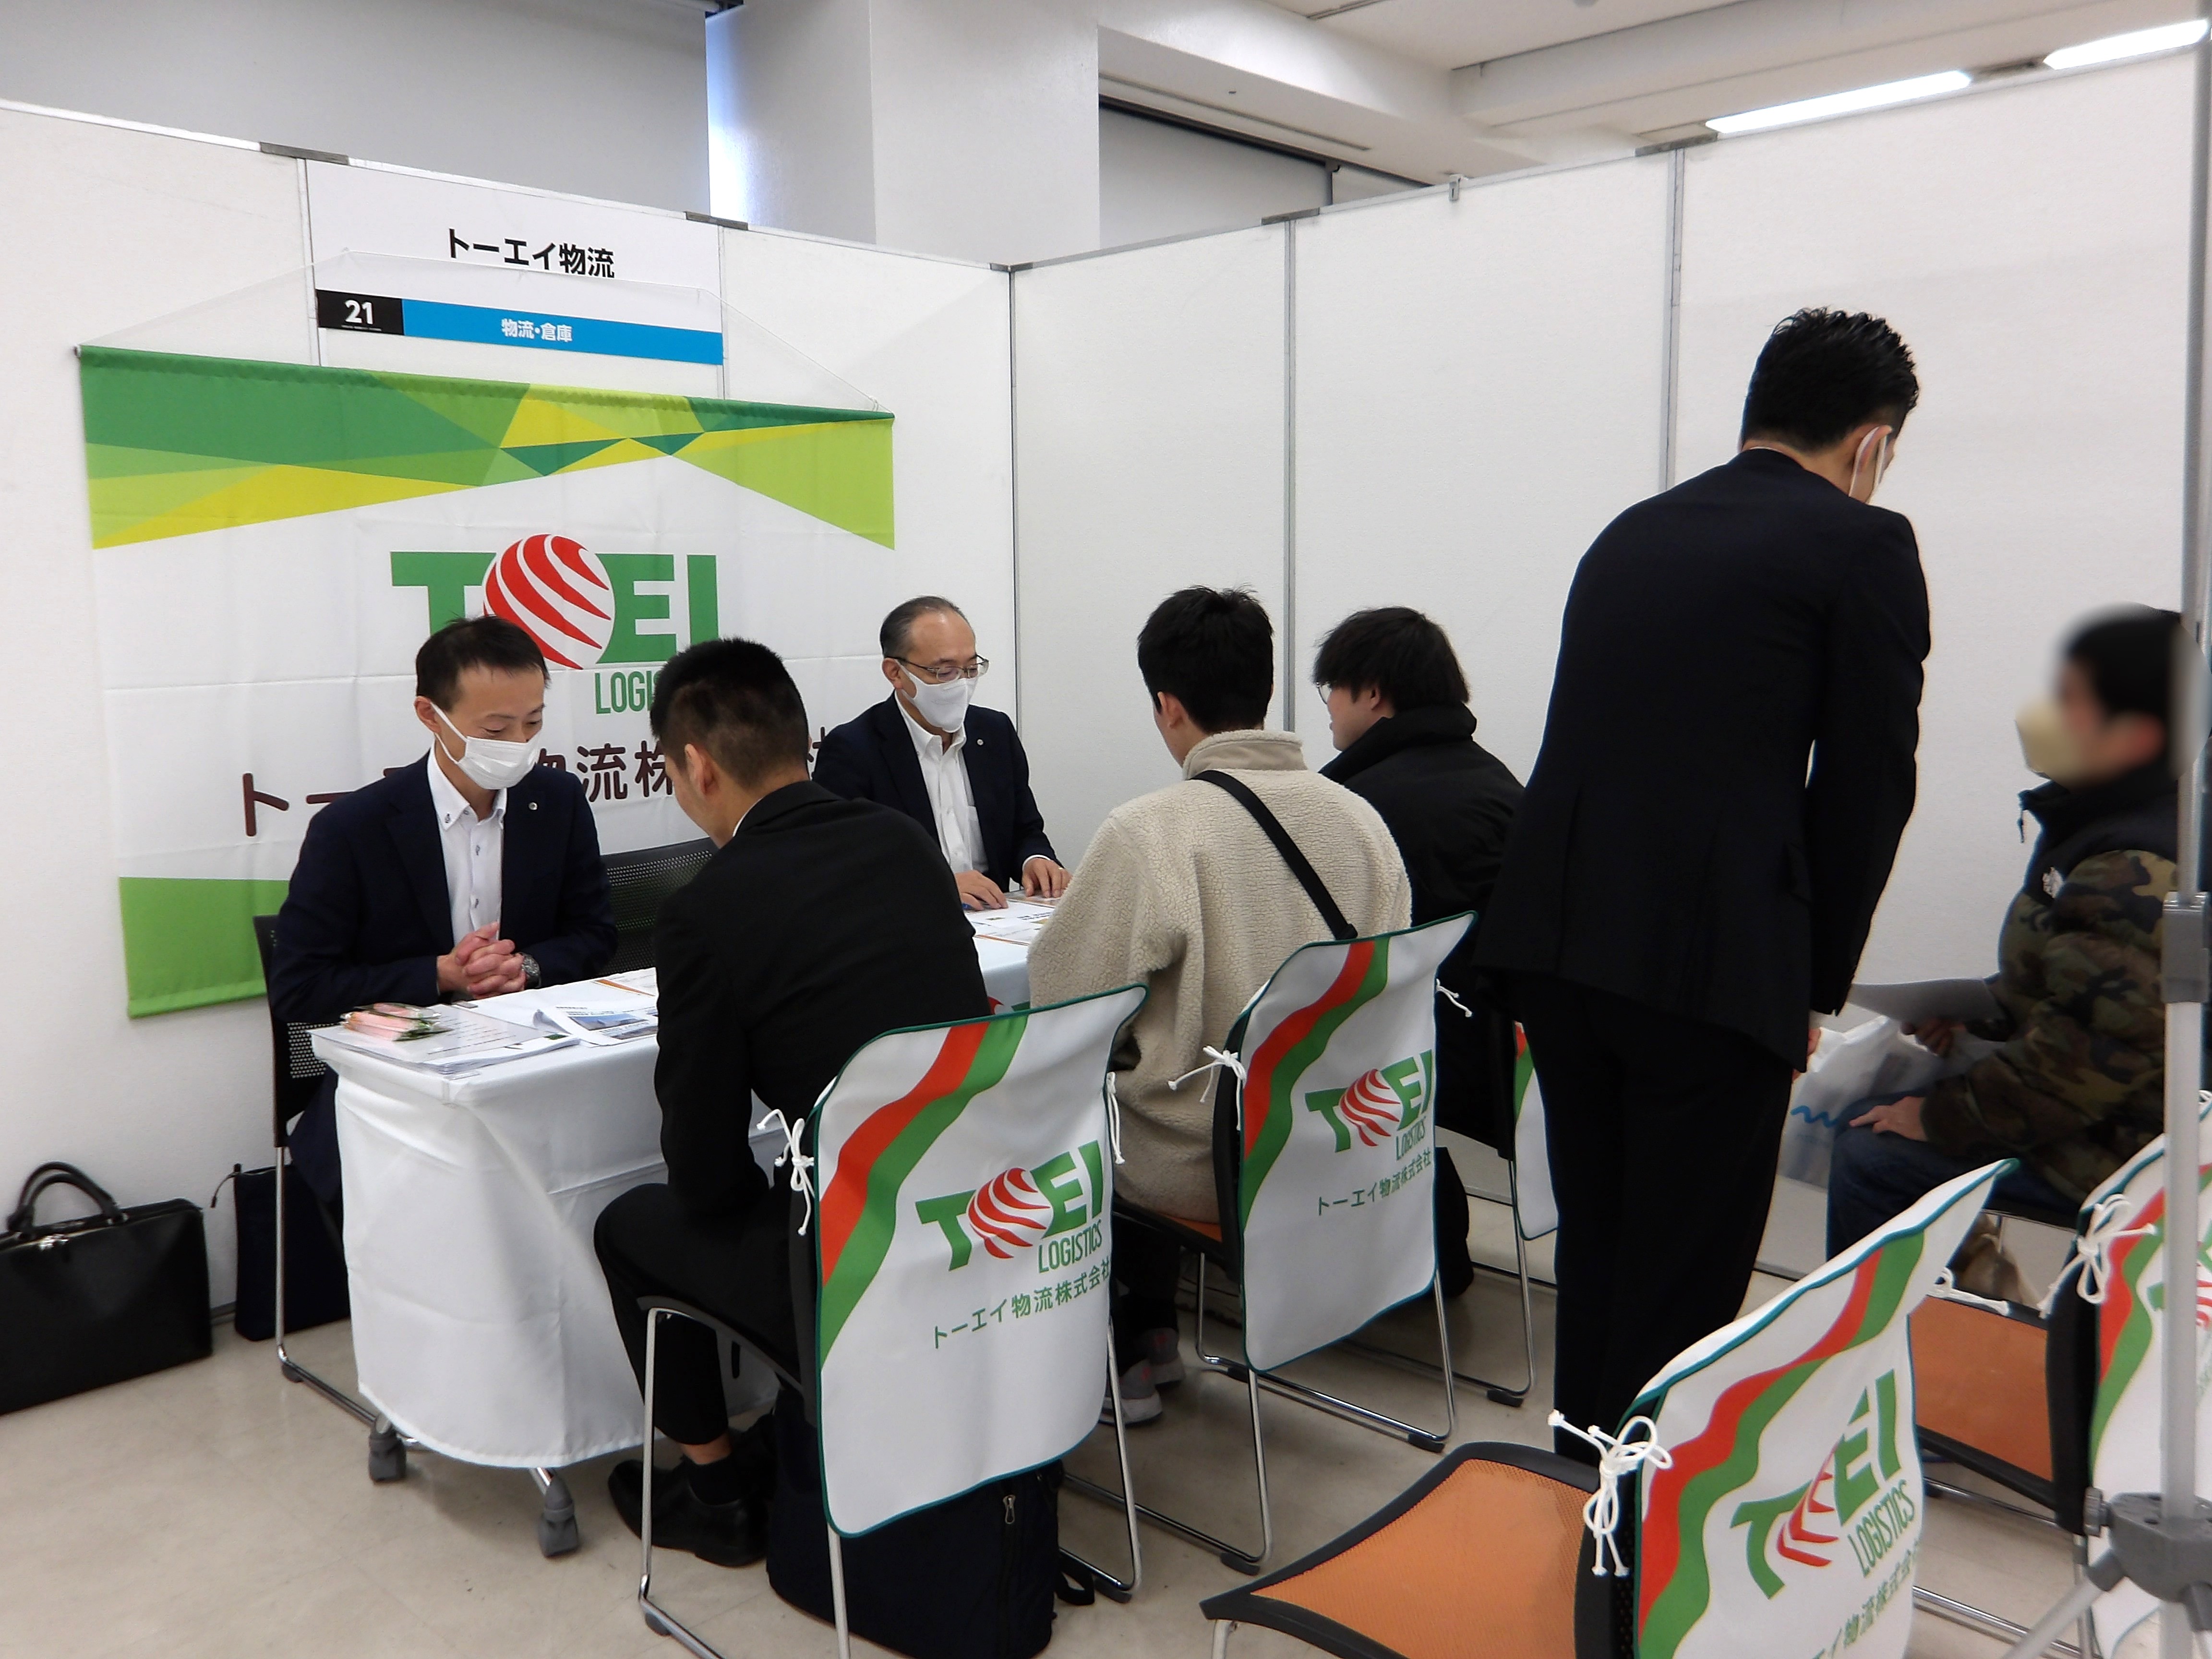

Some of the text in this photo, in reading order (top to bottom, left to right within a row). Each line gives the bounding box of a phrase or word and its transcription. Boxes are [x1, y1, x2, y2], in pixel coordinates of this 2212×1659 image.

[449, 228, 615, 278] トーエイ物流
[345, 300, 373, 325] 21
[501, 319, 573, 342] 物流・倉庫
[1038, 1219, 1102, 1273] LOGISTICS
